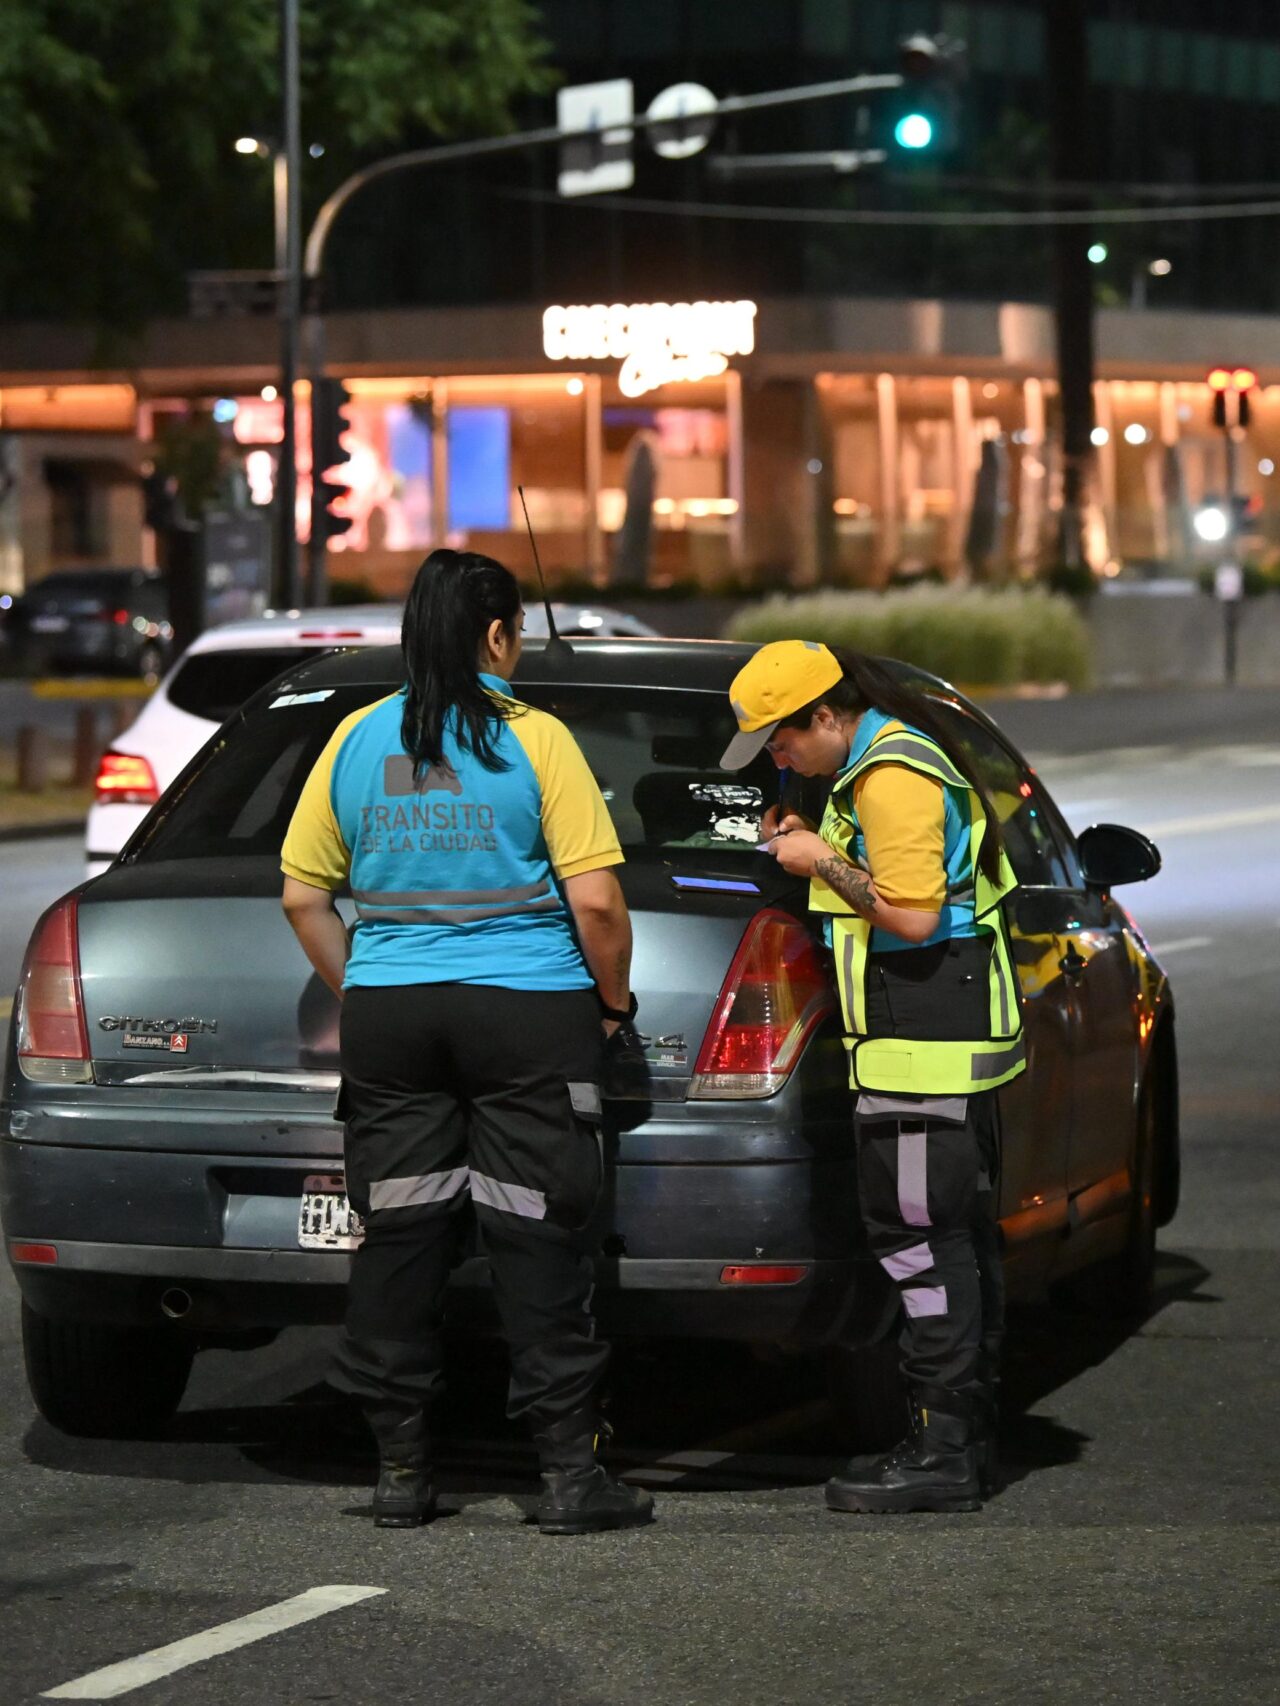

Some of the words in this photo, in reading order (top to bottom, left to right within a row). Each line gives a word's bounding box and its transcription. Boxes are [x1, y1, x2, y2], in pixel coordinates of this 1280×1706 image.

[361, 803, 495, 832] TRANSITO
[360, 834, 382, 853] DE
[389, 834, 414, 852] LA
[419, 832, 498, 851] CIUDAD
